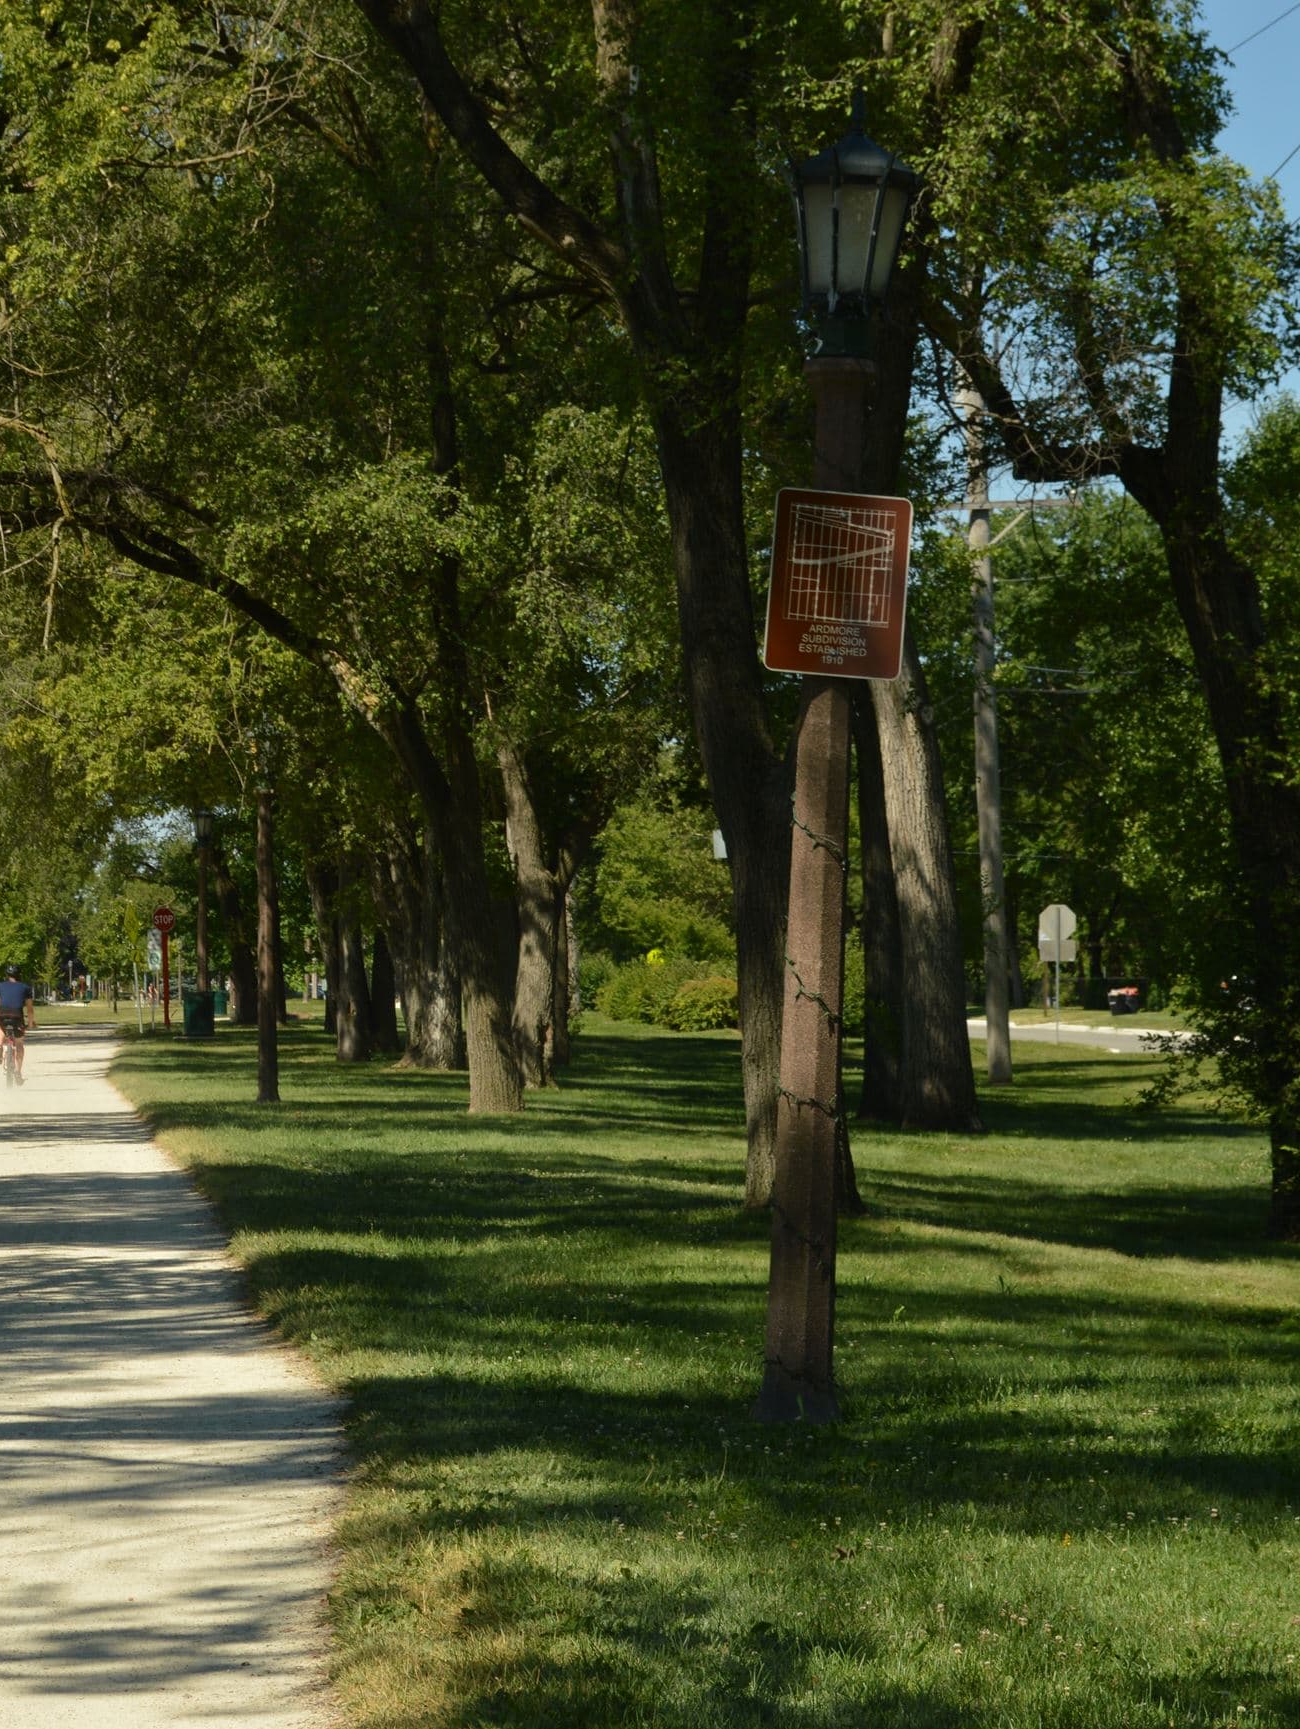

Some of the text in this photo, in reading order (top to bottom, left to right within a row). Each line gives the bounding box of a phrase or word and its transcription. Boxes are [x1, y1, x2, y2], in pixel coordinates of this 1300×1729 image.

[809, 624, 861, 637] ARDMORE
[801, 633, 867, 647] SUBDIVISION
[822, 655, 844, 665] 1910
[154, 914, 174, 925] STOP
